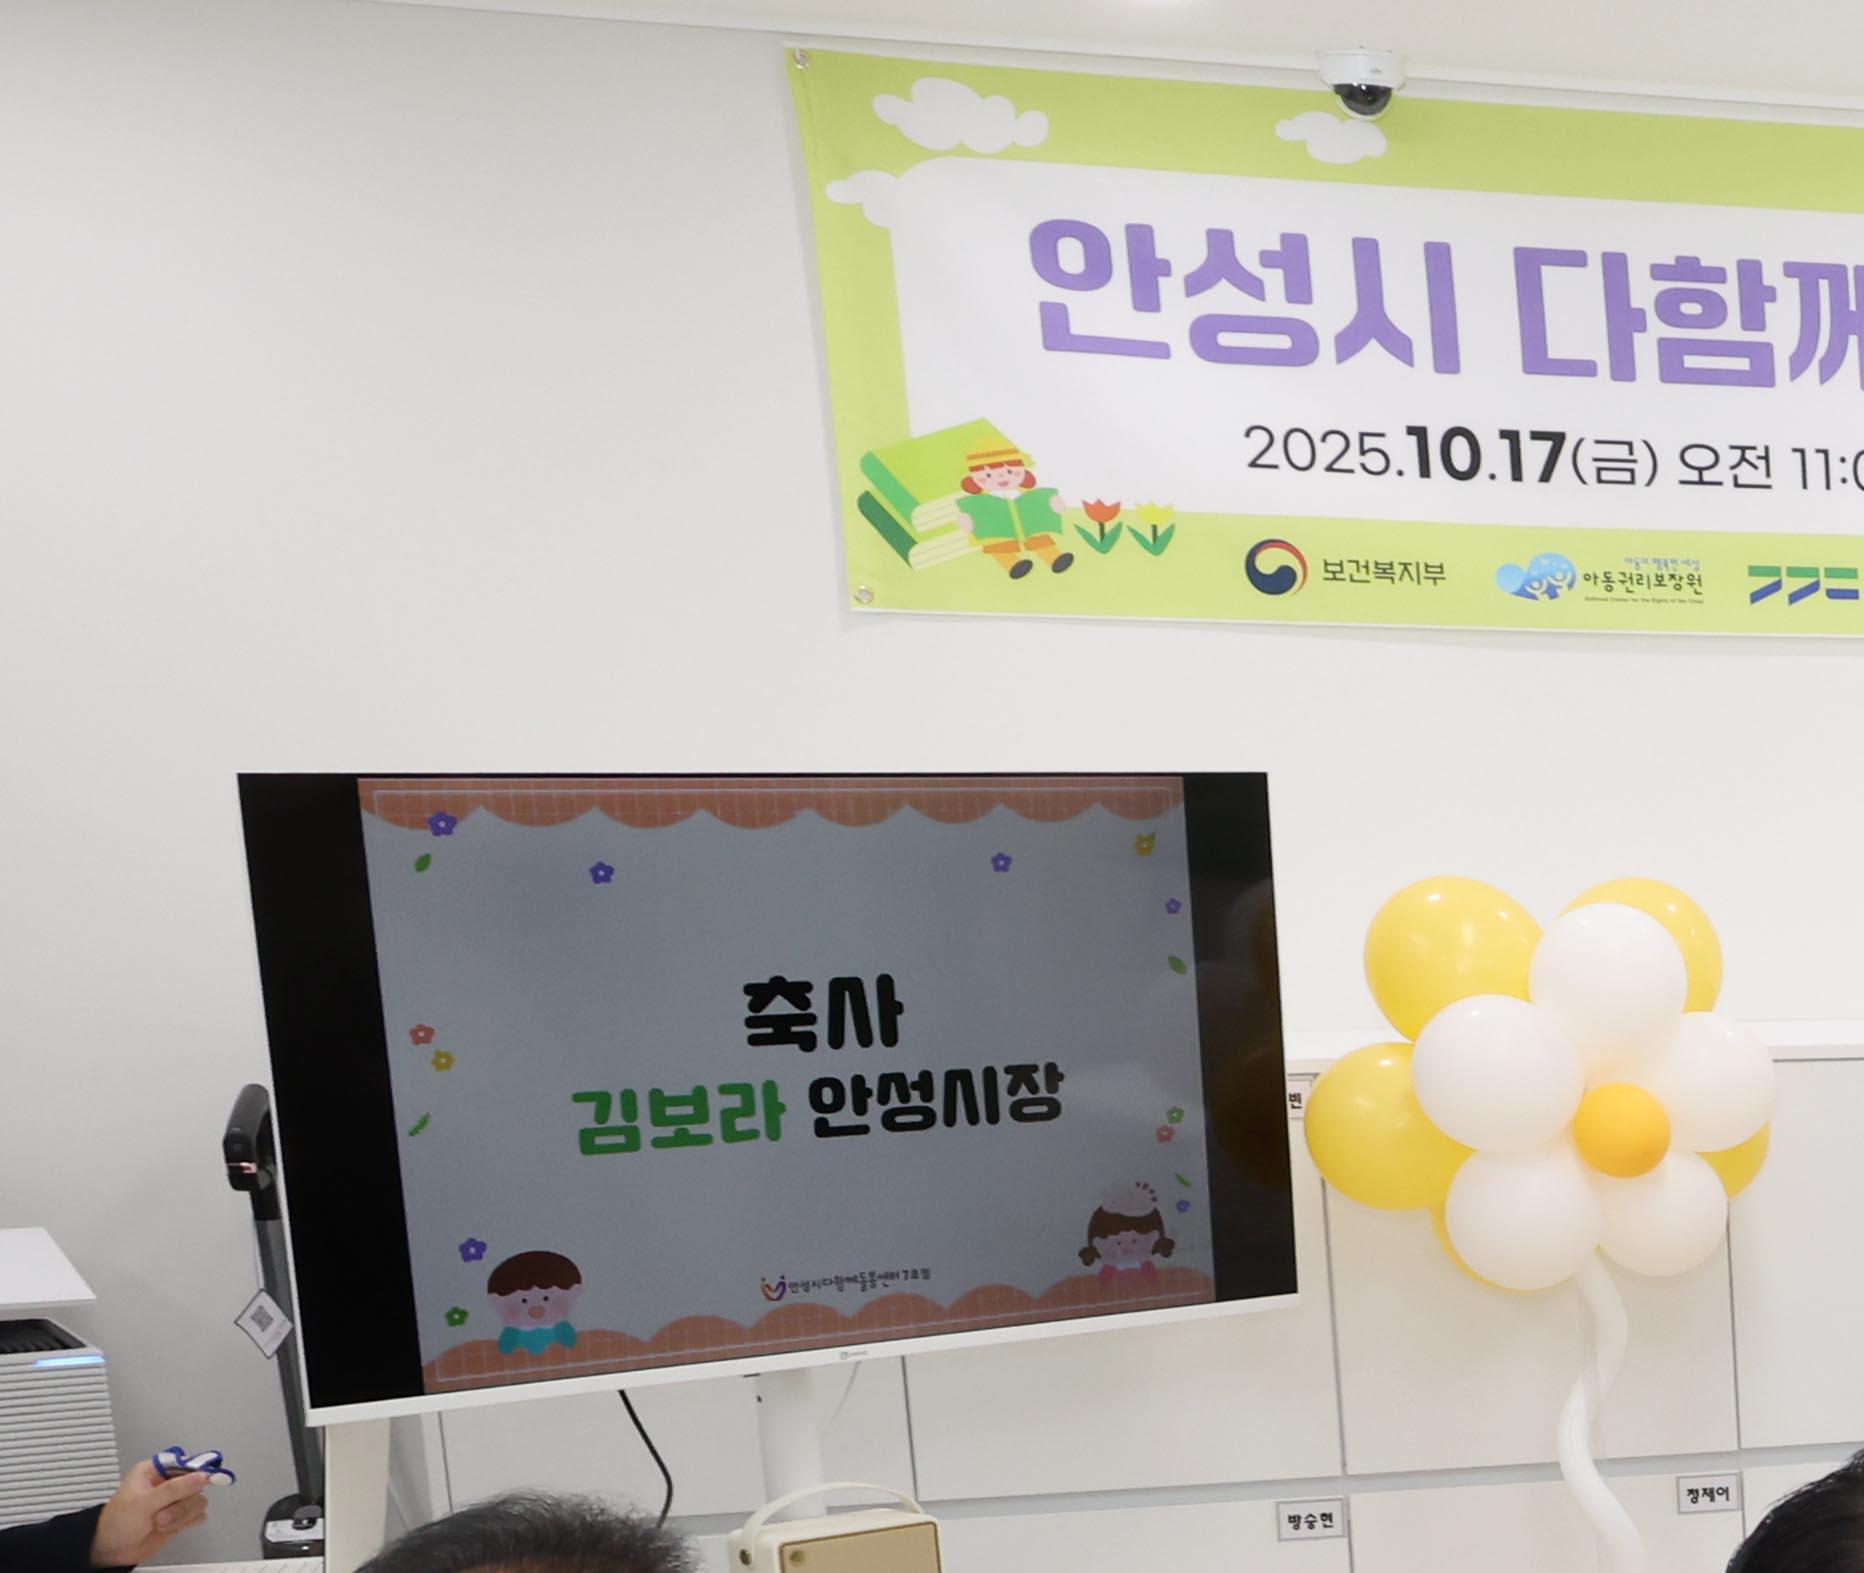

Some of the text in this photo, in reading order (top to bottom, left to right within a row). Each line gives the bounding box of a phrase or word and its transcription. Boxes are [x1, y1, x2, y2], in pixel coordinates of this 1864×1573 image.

[1029, 219, 1460, 374] 안성시
[1244, 425, 1658, 487] 2025.10.17(금)
[1679, 444, 1772, 489] 오전
[1324, 560, 1445, 585] 보건복지부
[1583, 572, 1702, 595] 아동권리보장원
[743, 974, 904, 1053] 축사
[571, 1062, 1065, 1156] 김보라 안성시장
[788, 1270, 901, 1292] 안성시다함께돌봄센터
[1288, 1513, 1333, 1530] 방승현
